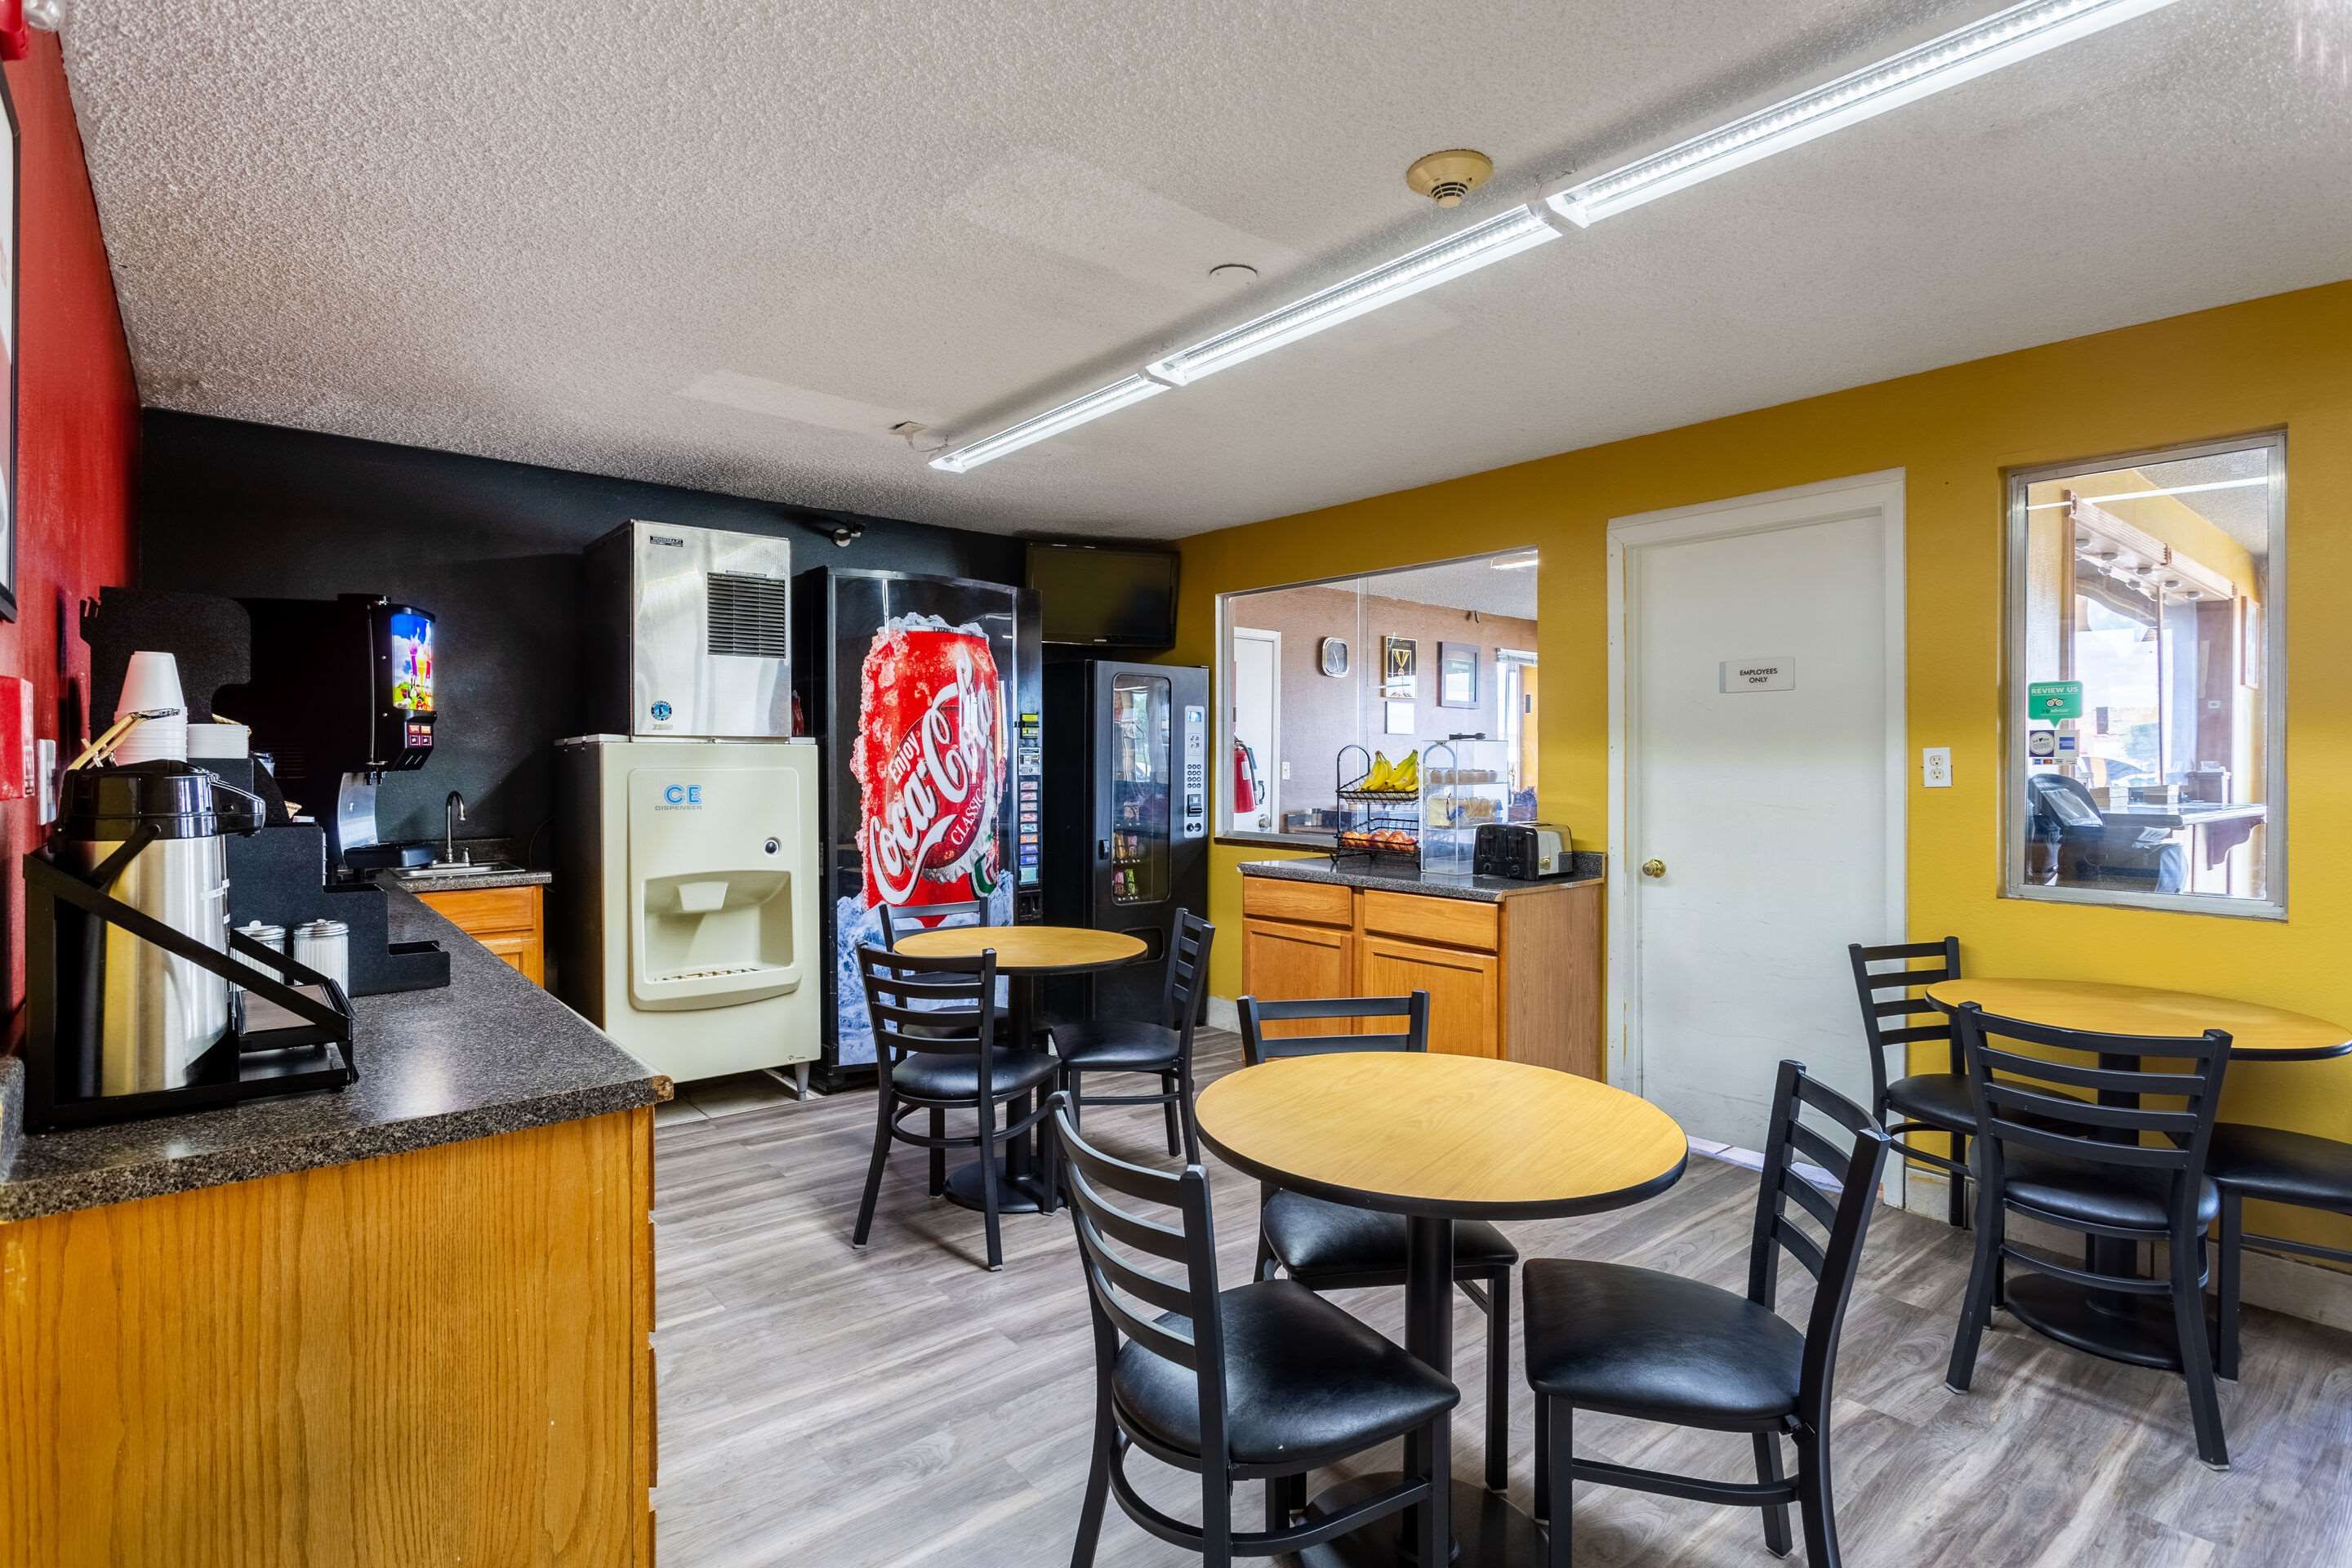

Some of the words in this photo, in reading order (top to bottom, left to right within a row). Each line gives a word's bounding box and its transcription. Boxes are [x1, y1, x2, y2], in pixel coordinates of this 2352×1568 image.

[870, 643, 993, 905] Coca-Cola
[888, 732, 921, 786] Enjoy
[951, 788, 985, 846] CLASSIC
